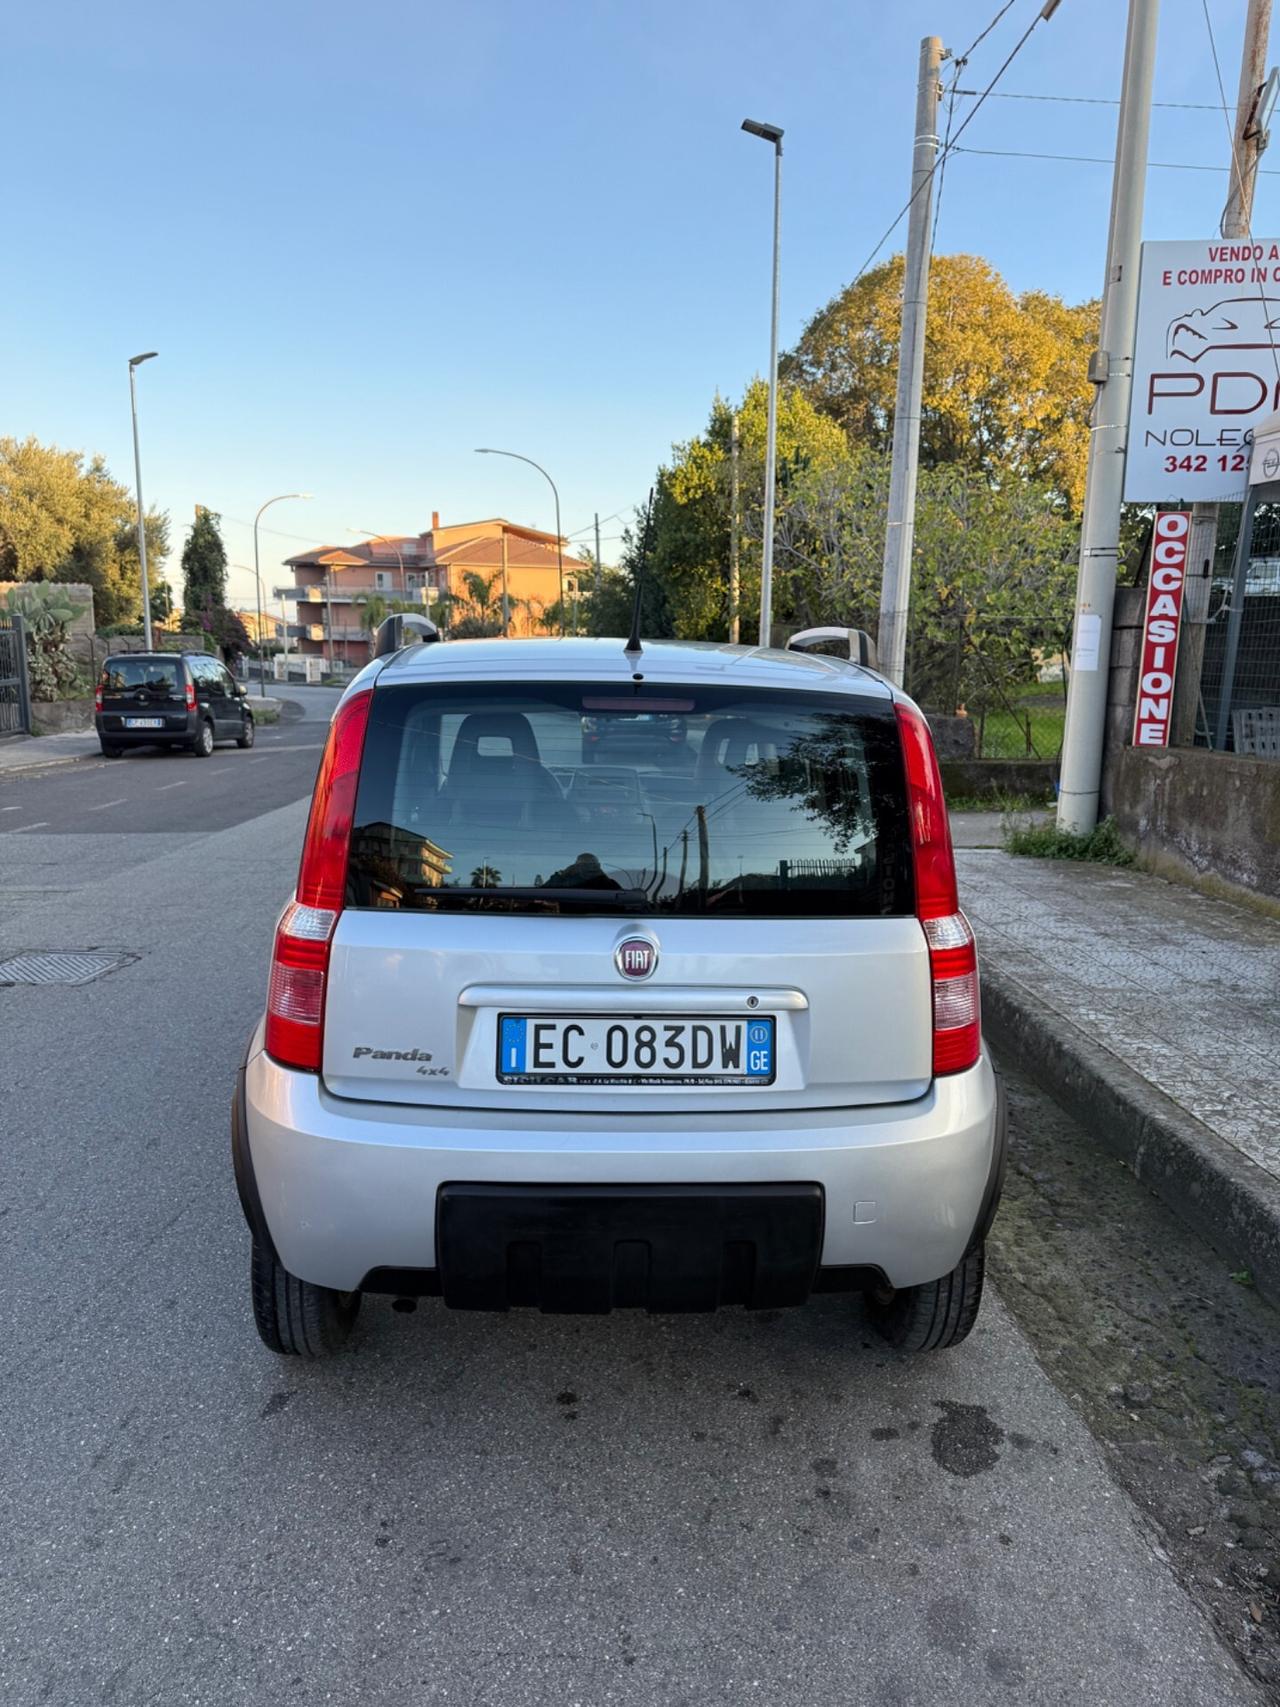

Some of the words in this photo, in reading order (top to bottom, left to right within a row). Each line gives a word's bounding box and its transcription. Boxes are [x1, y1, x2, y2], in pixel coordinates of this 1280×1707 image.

[1208, 245, 1263, 262] VENDO
[1162, 270, 1172, 286] E
[1177, 267, 1245, 285] COMPRO
[1251, 267, 1268, 283] IN
[1147, 371, 1280, 415] PD
[1164, 454, 1208, 473] 342
[1217, 453, 1250, 472] 12
[1138, 513, 1190, 746] OCCASIONE
[625, 950, 650, 970] FIAT
[352, 1046, 433, 1062] Panda
[510, 1047, 517, 1068] I
[532, 1023, 586, 1070] EC
[605, 1024, 742, 1071] 083DW
[750, 1050, 769, 1071] GE
[416, 1066, 450, 1077] 4x4
